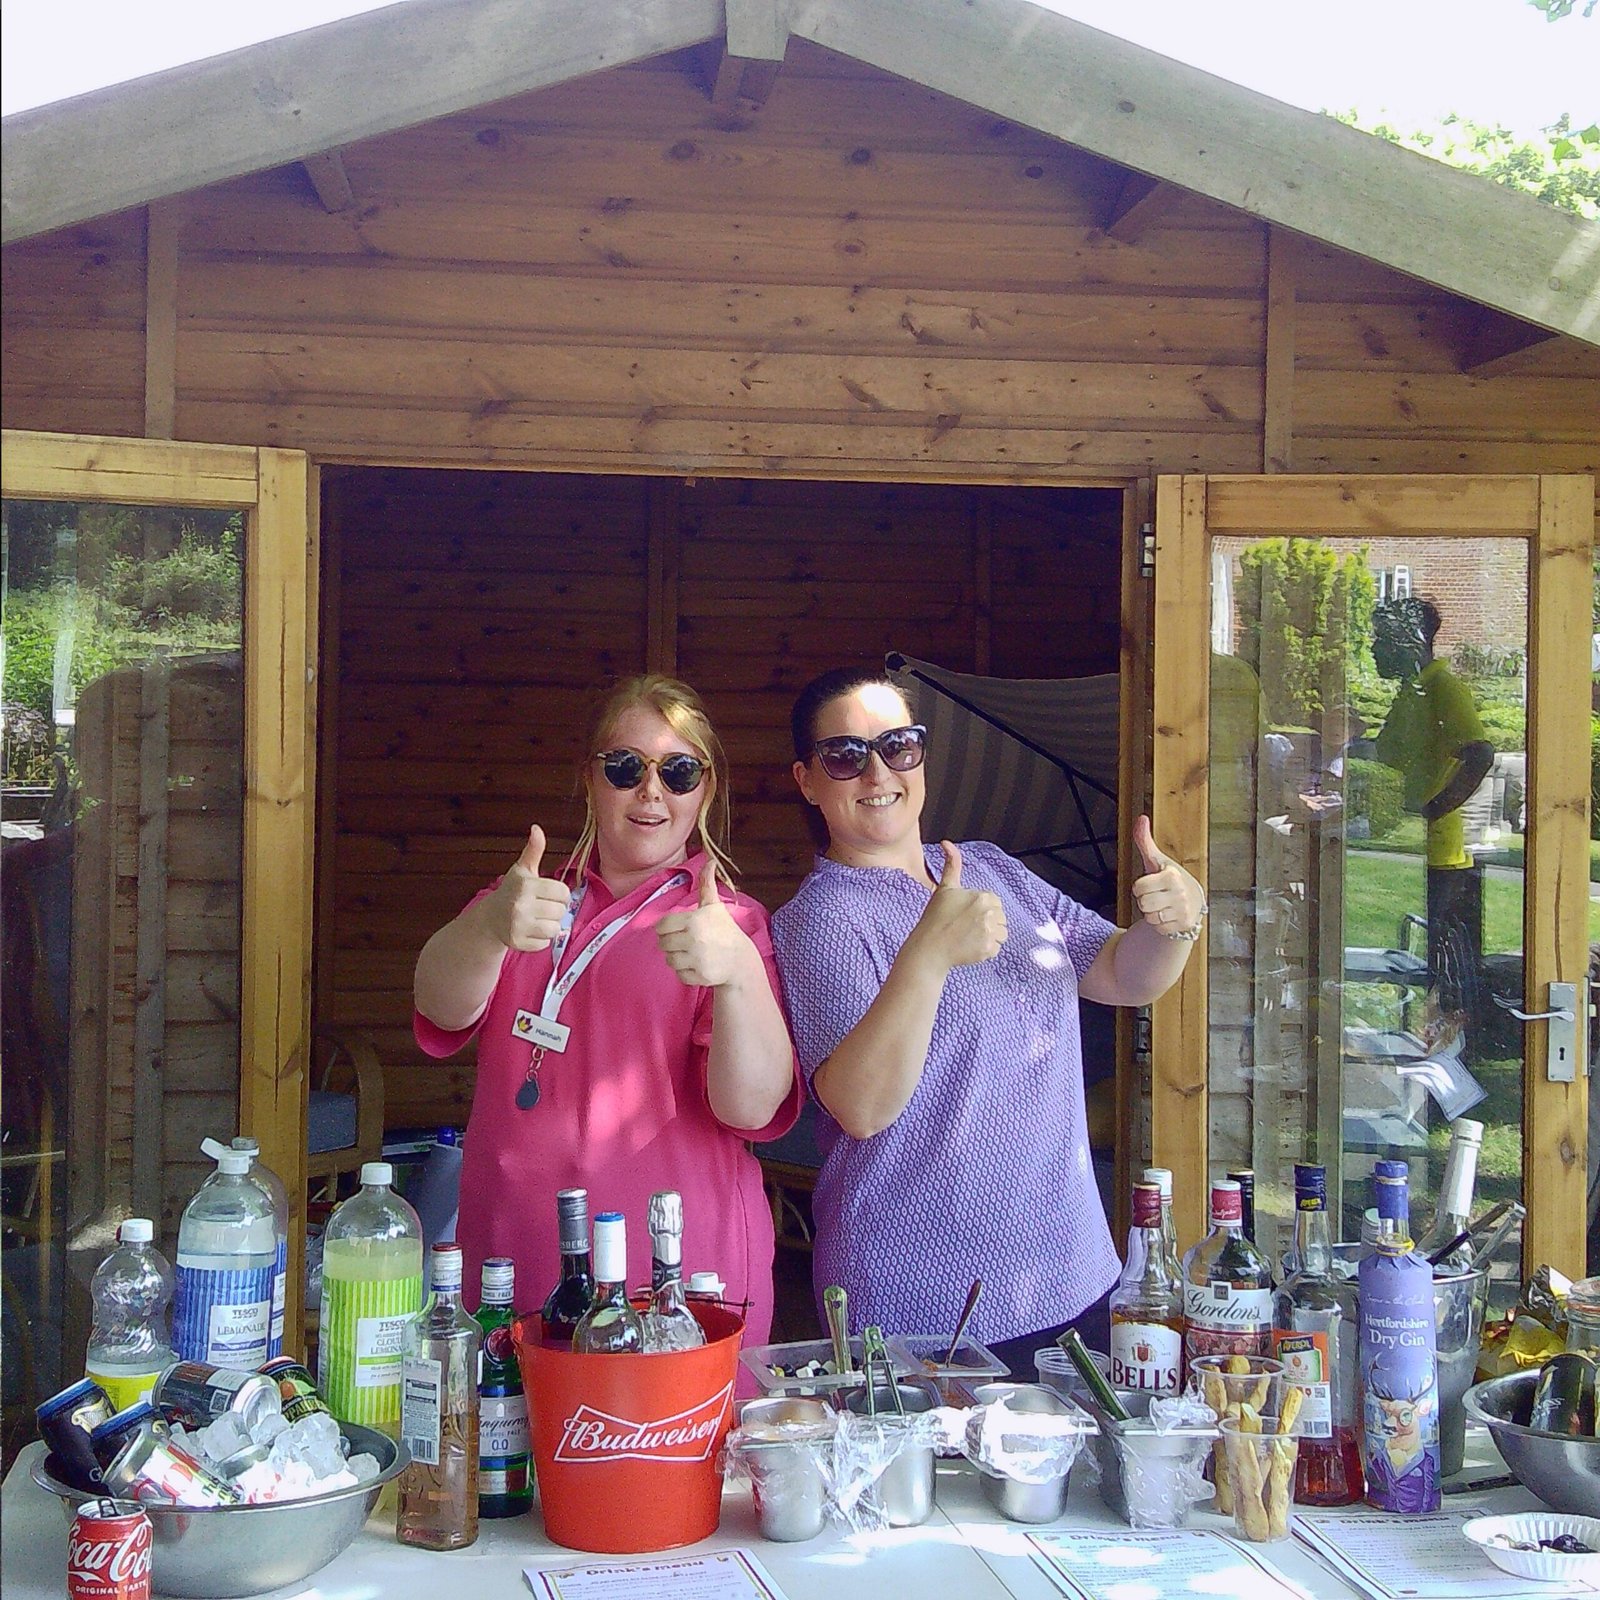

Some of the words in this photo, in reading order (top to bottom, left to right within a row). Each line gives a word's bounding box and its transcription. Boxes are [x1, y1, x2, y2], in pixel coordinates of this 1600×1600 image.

[1187, 1289, 1262, 1321] Gordon's
[231, 1308, 259, 1319] TESCO
[1365, 1312, 1429, 1329] Hertfordshire
[217, 1322, 266, 1335] LEMONADE
[379, 1320, 406, 1331] TESCO
[1369, 1328, 1398, 1349] Dry
[1399, 1331, 1425, 1347] Gin
[1112, 1356, 1178, 1392] BELL'S
[563, 1414, 722, 1451] Budweiser
[491, 1438, 509, 1451] 0.0
[75, 1585, 120, 1595] ORIGINAL
